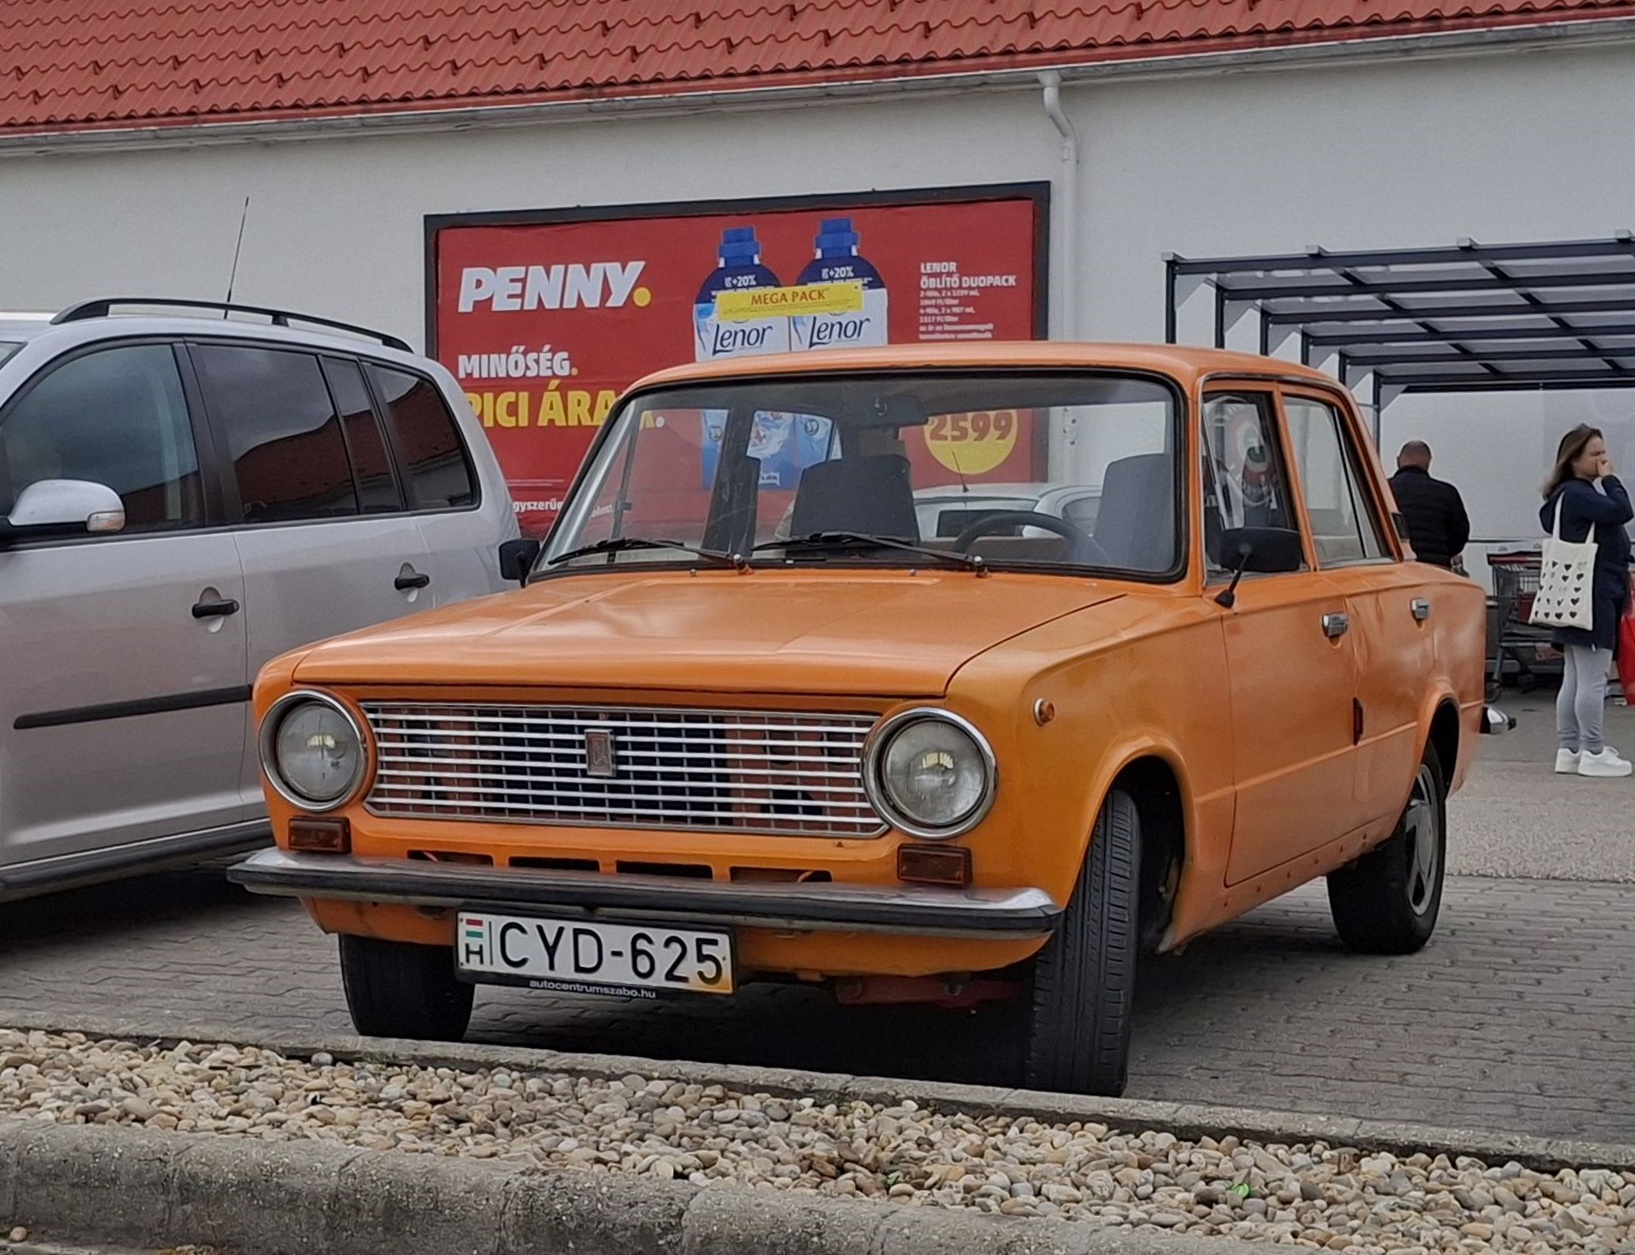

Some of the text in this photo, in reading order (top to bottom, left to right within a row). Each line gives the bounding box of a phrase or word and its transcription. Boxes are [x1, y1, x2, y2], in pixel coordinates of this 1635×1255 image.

[920, 262, 957, 273] LENOR
[962, 275, 1016, 287] DUOPACK
[751, 291, 788, 306] MEGA
[712, 323, 773, 357] Lenor
[808, 316, 871, 349] Lenor
[929, 411, 1013, 441] 2599
[465, 922, 723, 986] H CYD-625
[529, 978, 656, 999] autocentrumszabo.hu
